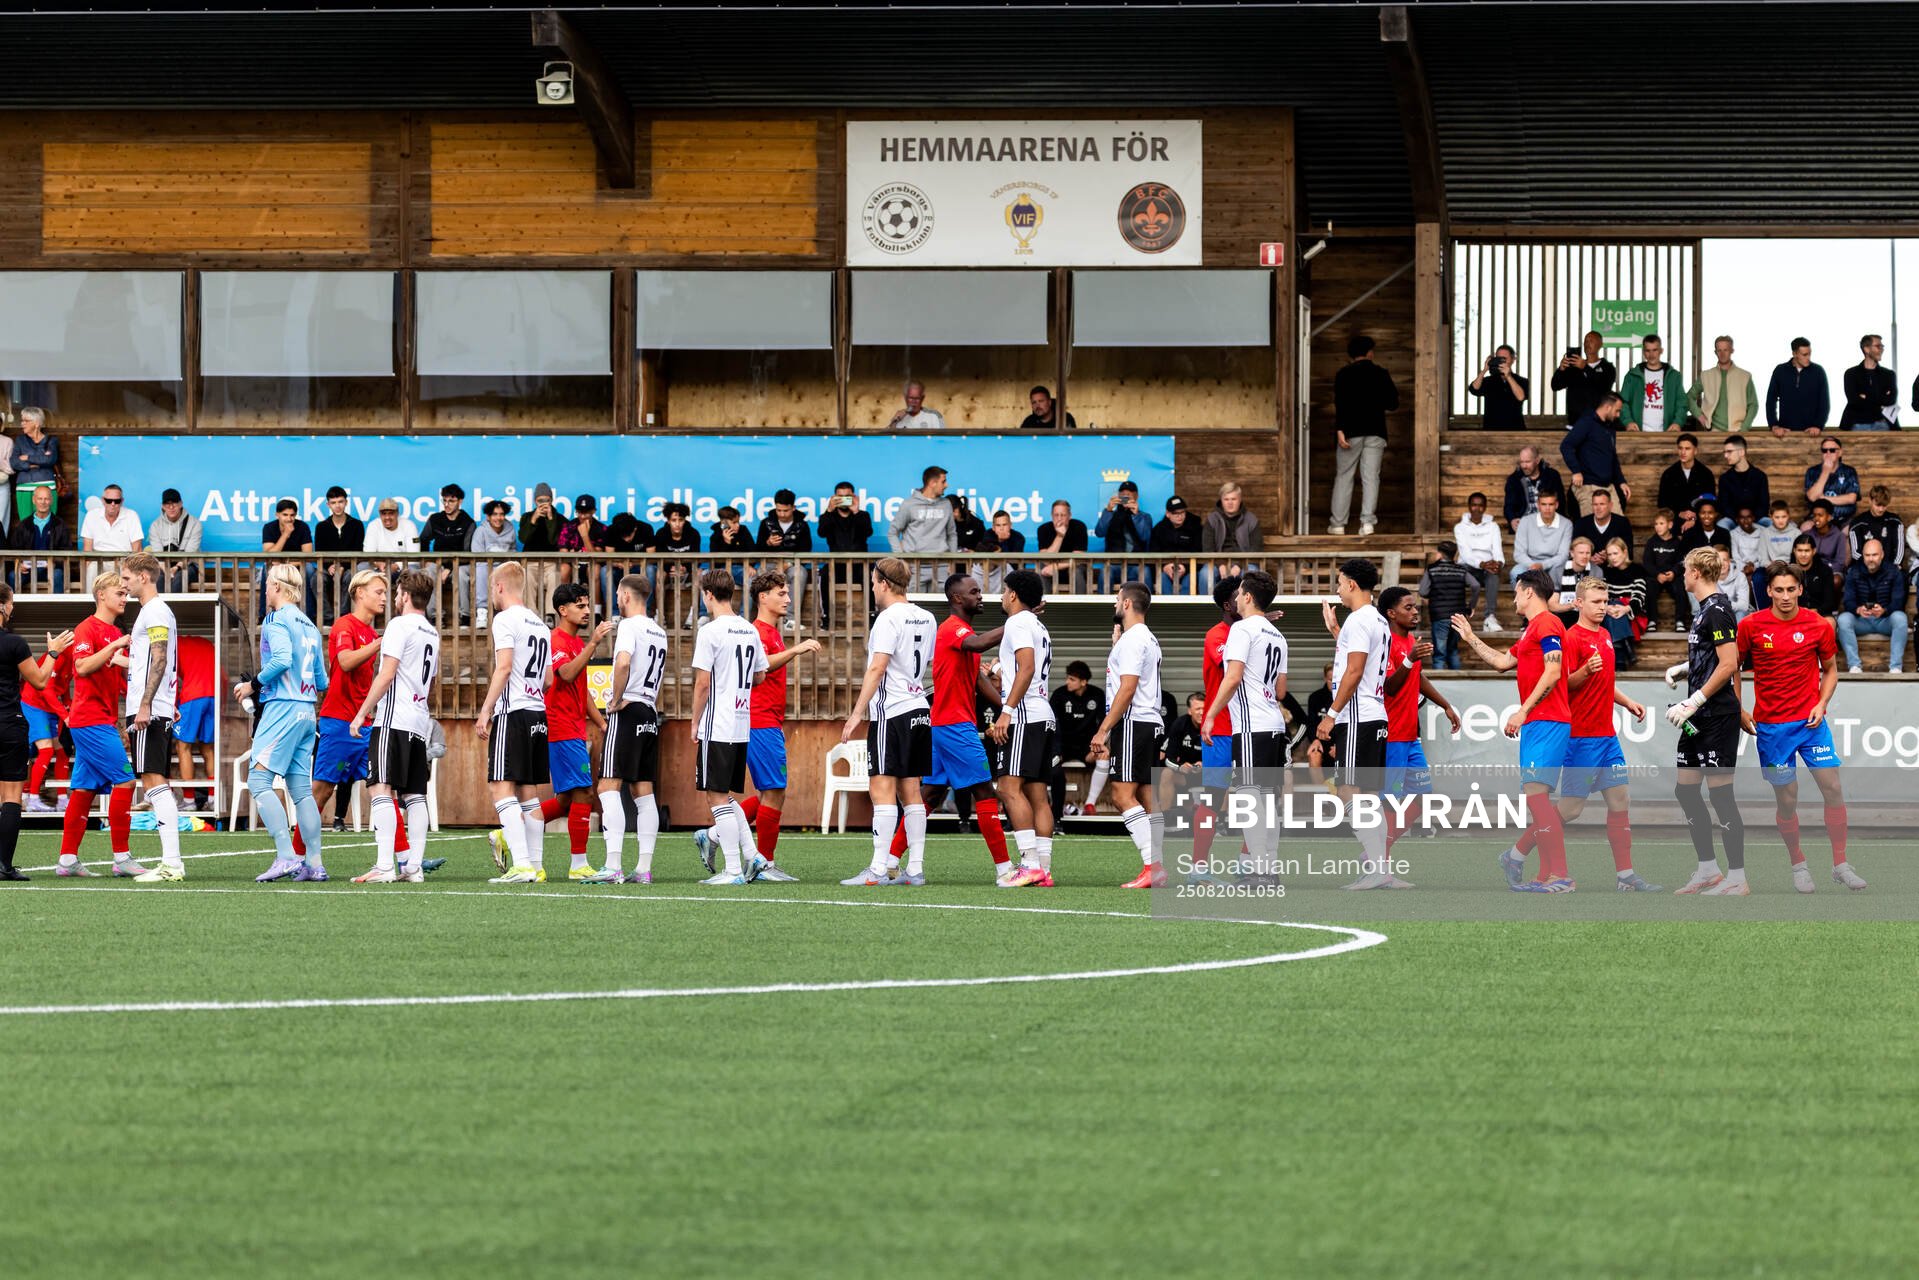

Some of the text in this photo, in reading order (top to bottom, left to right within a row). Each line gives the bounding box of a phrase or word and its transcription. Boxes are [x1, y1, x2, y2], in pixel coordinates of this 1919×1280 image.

[881, 131, 1170, 162] HEMMAARENA FÖR
[1135, 185, 1169, 199] BFC
[1013, 213, 1036, 225] VIF
[1595, 307, 1655, 325] Utgång
[200, 488, 377, 522] Attrkiv
[392, 488, 452, 522] oc
[473, 486, 615, 522] hålbr
[422, 643, 433, 685] 6
[524, 634, 548, 680] 20
[643, 644, 666, 691] 23
[735, 644, 755, 689] 12
[1264, 642, 1281, 685] 10
[1428, 764, 1521, 777] EKRYTERIN
